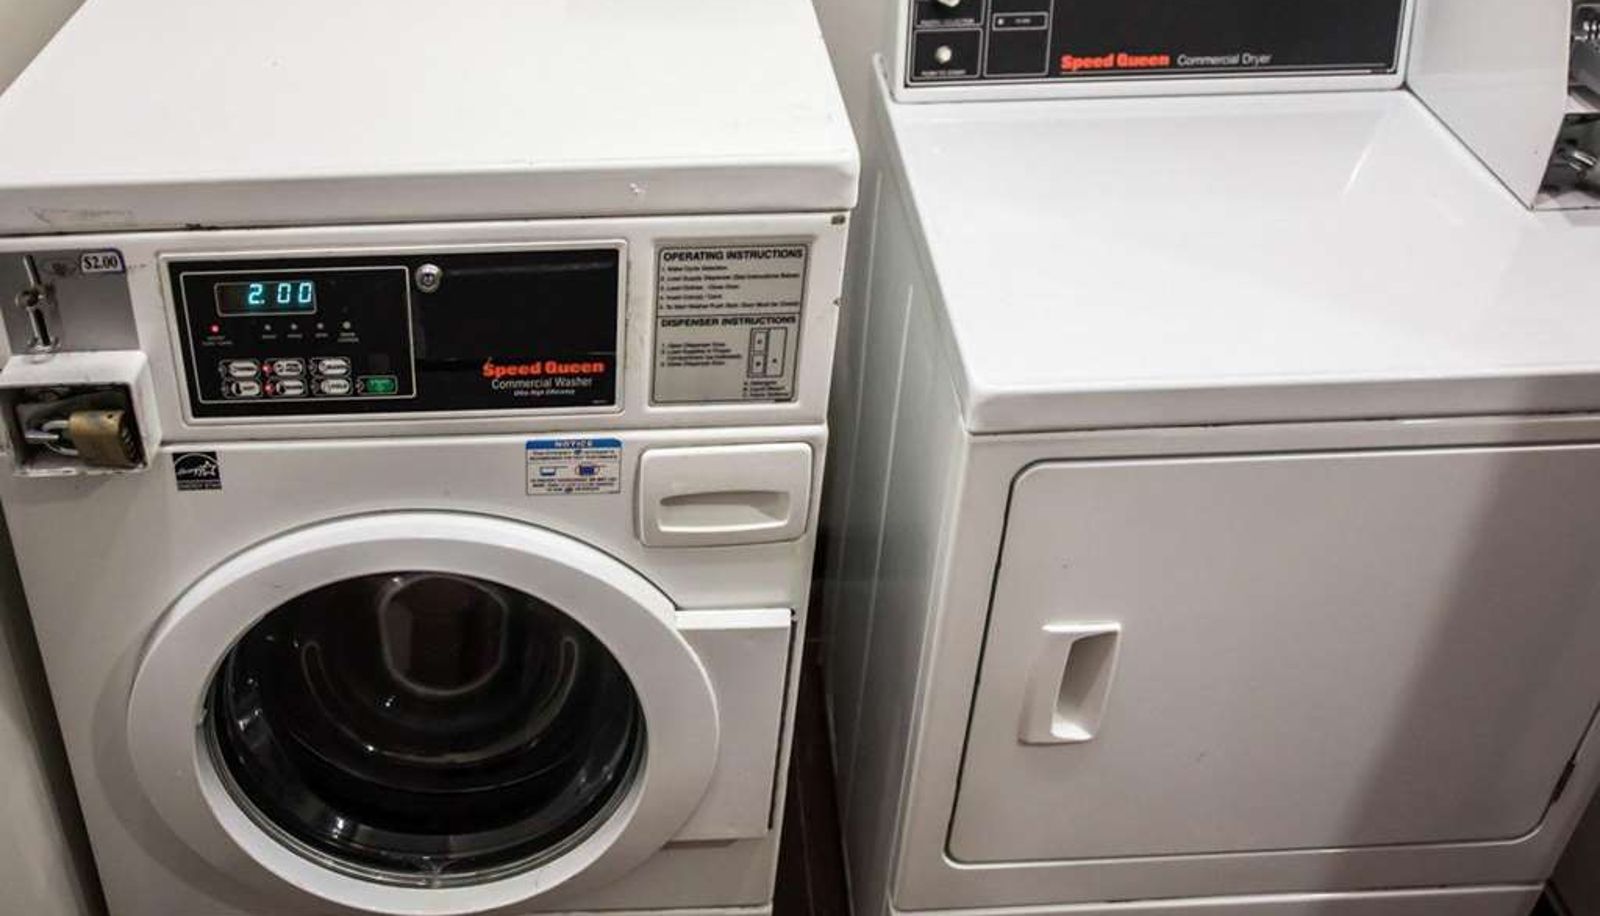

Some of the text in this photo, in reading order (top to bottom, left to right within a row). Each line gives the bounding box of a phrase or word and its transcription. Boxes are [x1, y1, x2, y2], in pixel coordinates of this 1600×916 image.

[1061, 52, 1272, 71] Speed Queen Commercial Dryer
[84, 255, 118, 270] $2.00
[663, 249, 803, 261] OPERATING INSTRUCTIONS
[249, 282, 312, 304] 2.00
[661, 316, 796, 327] DISPENSER INSTRUCTIONS
[482, 360, 605, 378] Speed Queen
[491, 376, 592, 390] Commercial Washer
